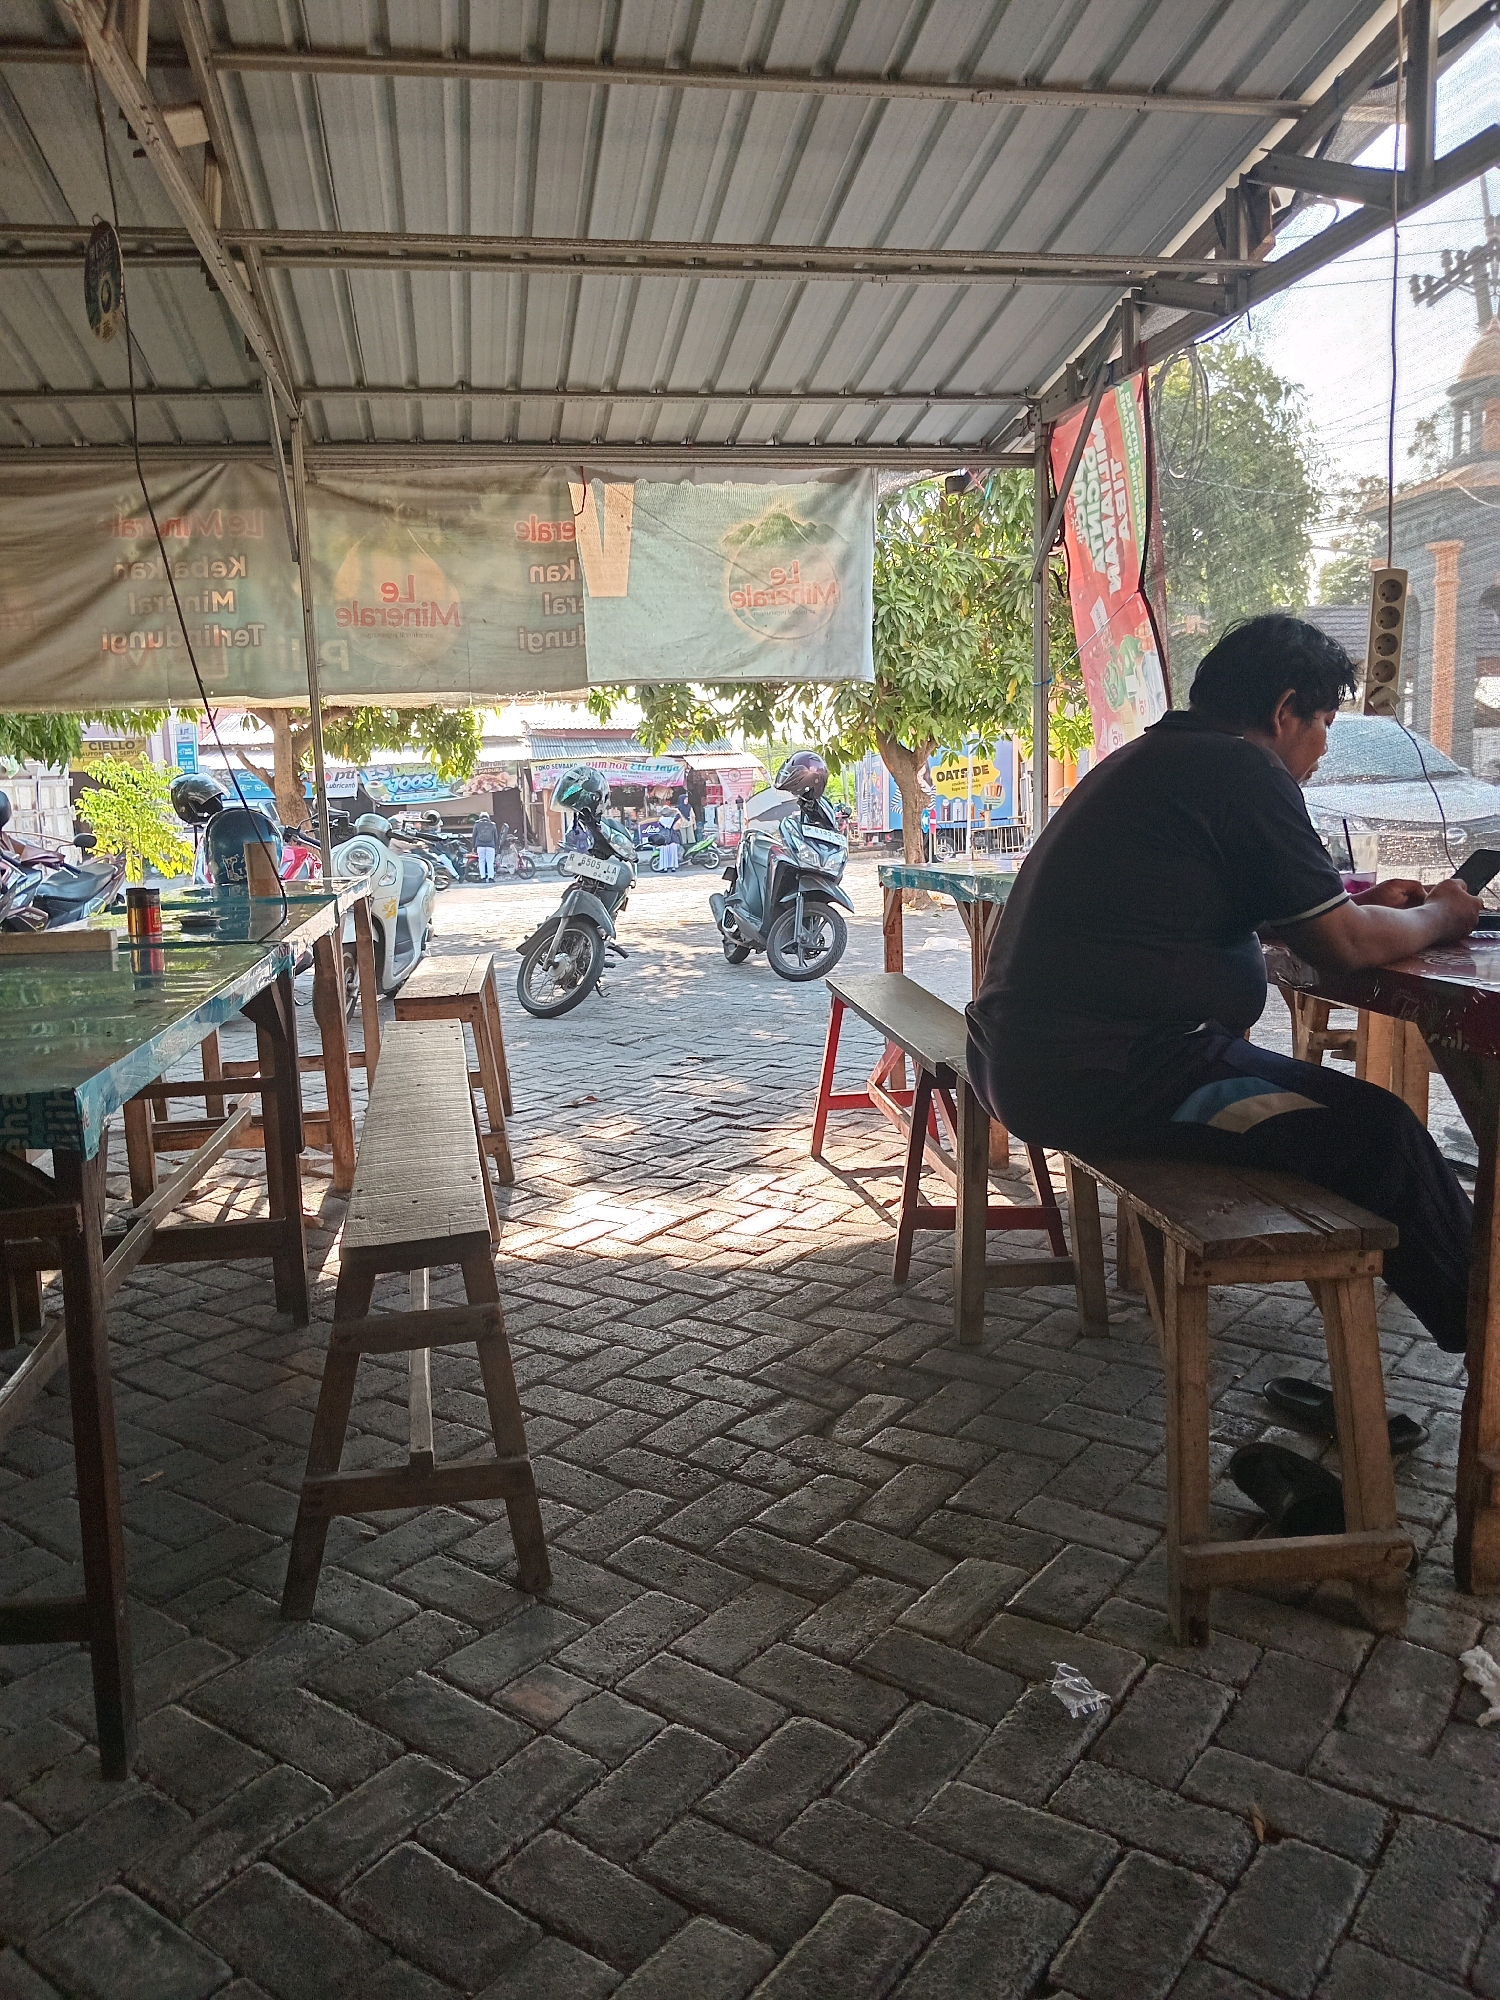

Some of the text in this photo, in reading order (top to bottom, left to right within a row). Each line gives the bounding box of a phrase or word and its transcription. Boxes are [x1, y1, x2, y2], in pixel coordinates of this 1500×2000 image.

[88, 740, 136, 751] CIELLO
[364, 763, 438, 781] ES DEGA
[935, 764, 990, 782] OATSDE
[388, 774, 435, 793] JOOS
[569, 853, 617, 874] R 6505 LA
